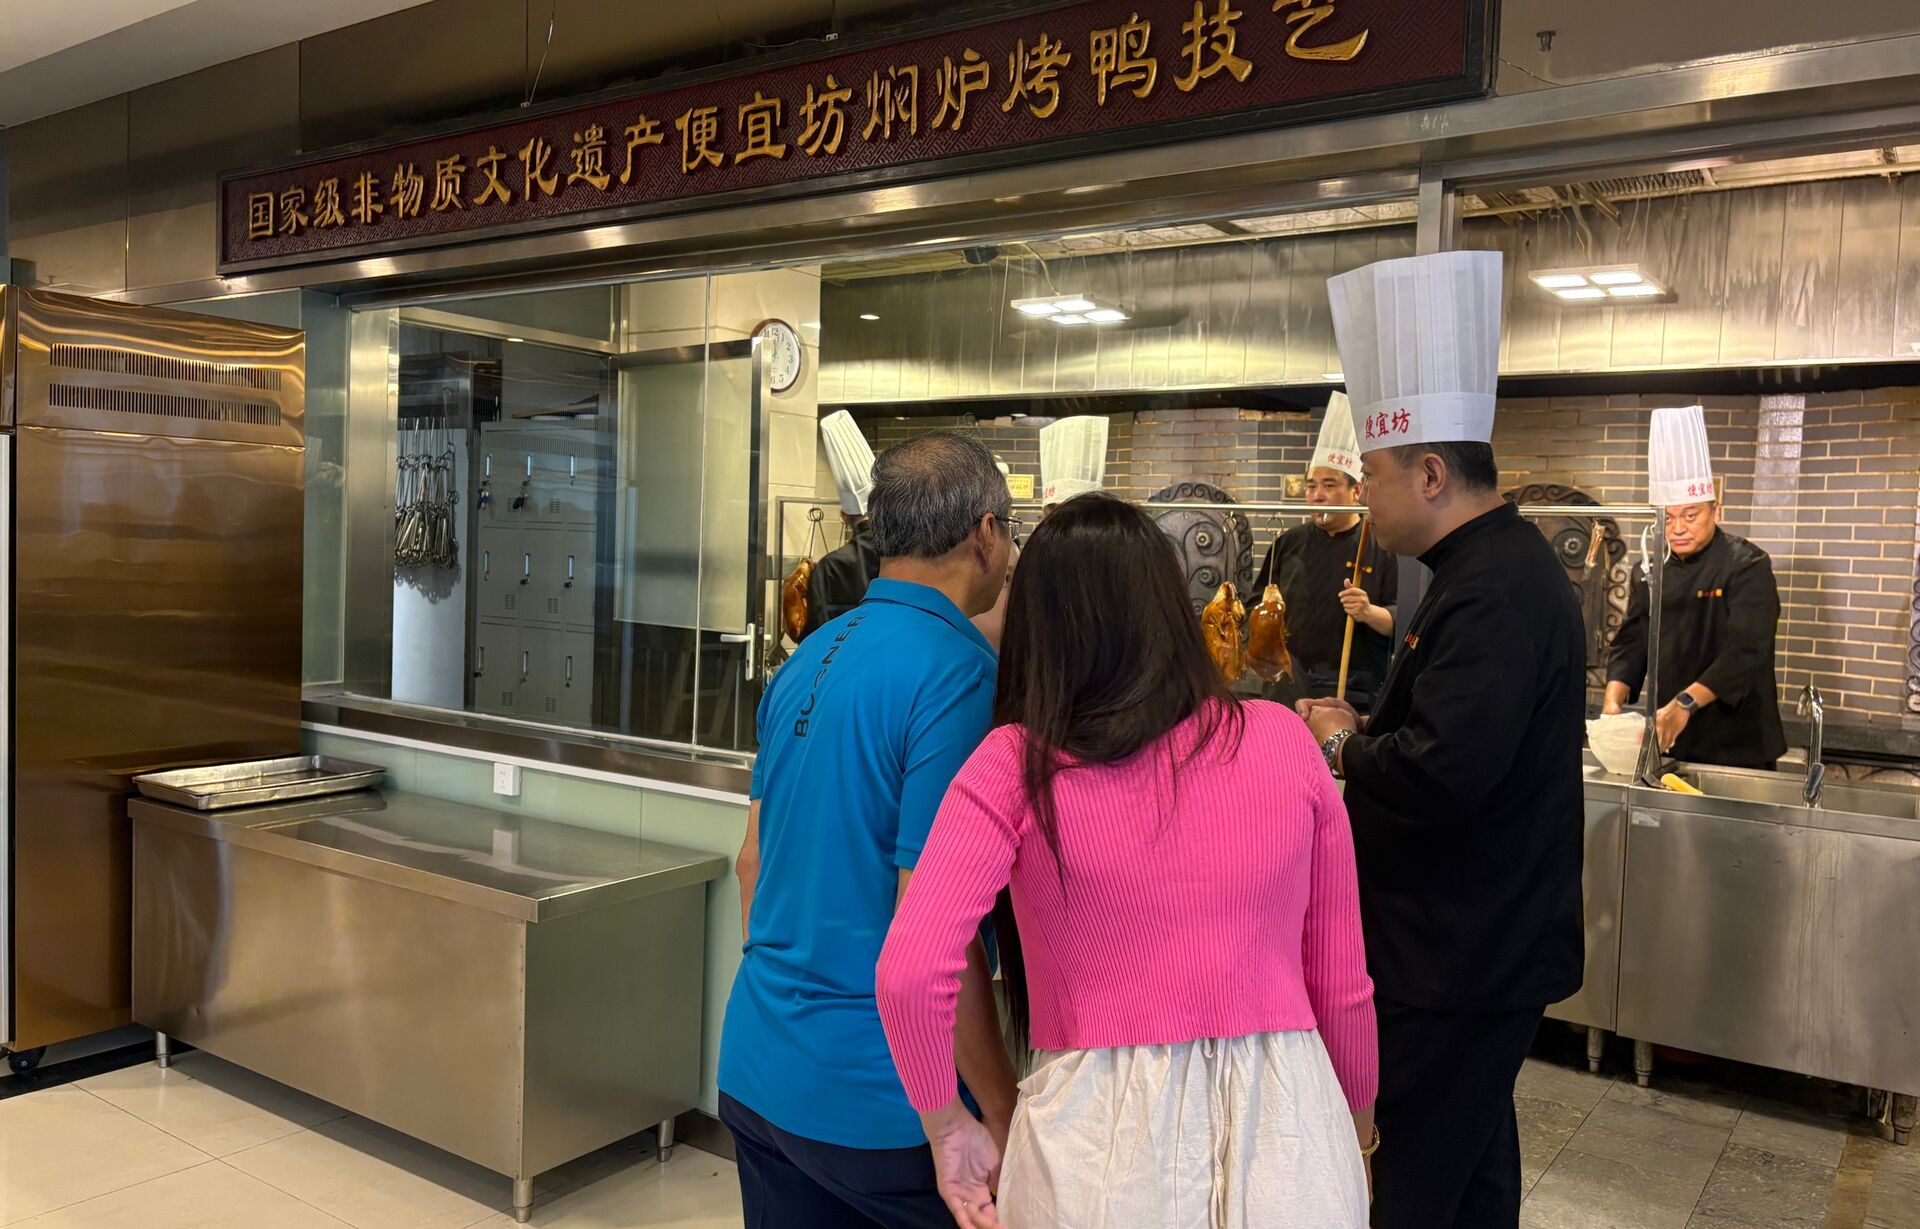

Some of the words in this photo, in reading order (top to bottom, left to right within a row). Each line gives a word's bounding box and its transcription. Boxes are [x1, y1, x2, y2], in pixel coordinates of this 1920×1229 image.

[248, 0, 1369, 240] 国家级非物质文化遗产便宜坊焖炉烤鸭技艺
[771, 327, 779, 337] 12
